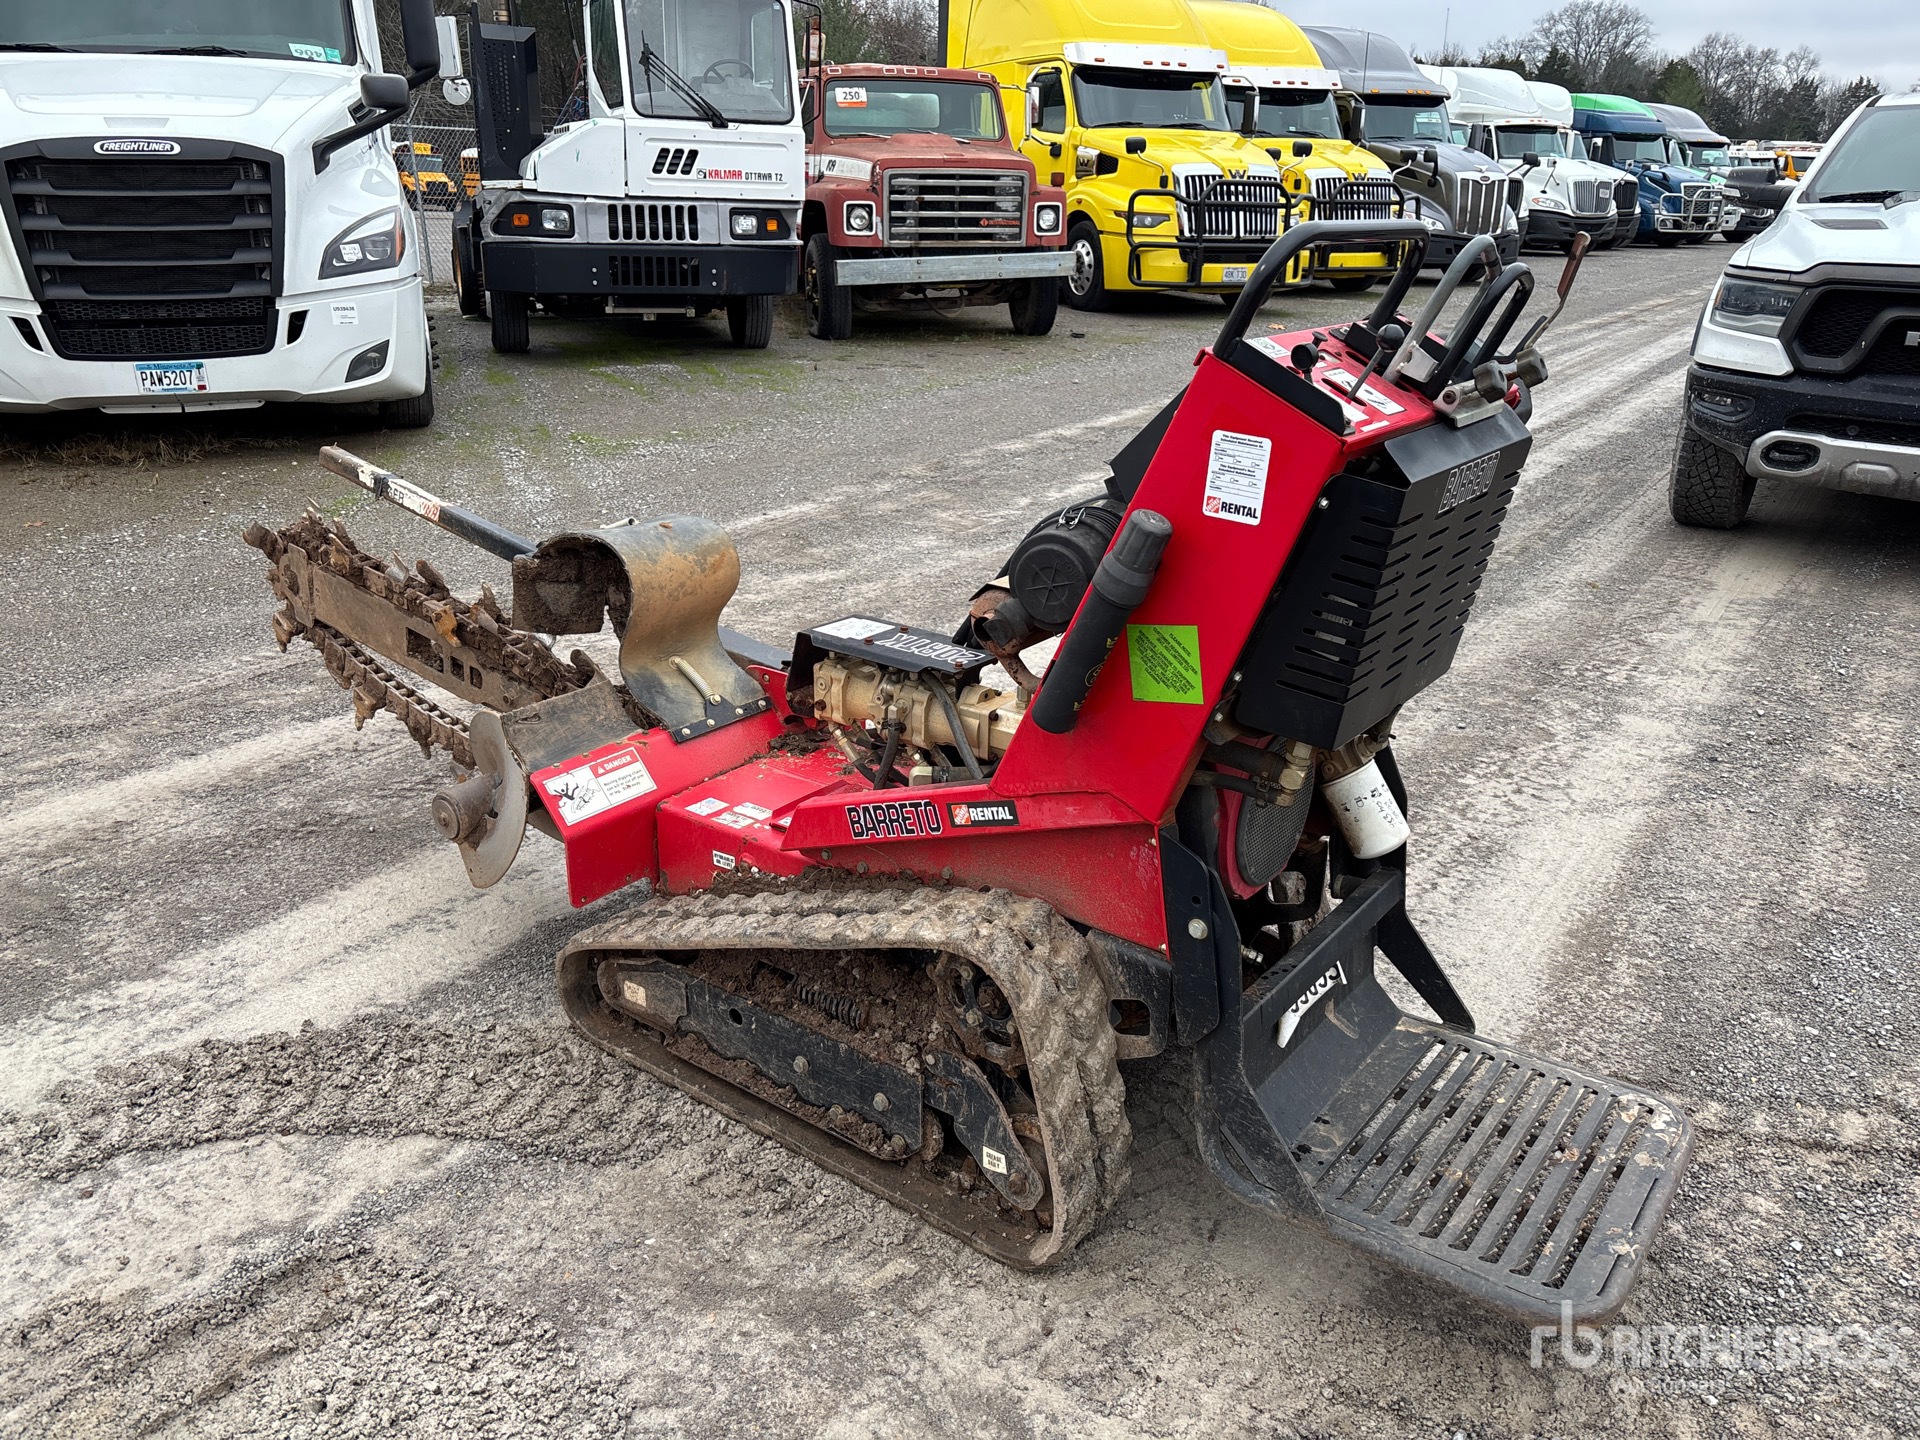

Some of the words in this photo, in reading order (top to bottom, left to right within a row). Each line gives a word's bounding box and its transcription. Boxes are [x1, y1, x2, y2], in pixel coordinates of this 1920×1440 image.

[842, 91, 860, 101] 250
[102, 142, 171, 151] FREIGHTLINER
[708, 169, 743, 180] KALMAR
[744, 171, 773, 181] OTTAWA
[774, 173, 783, 182] T2
[140, 369, 193, 387] PAW5207
[1438, 450, 1500, 514] BARRETO
[1220, 501, 1258, 519] RENTAL
[1169, 633, 1181, 646] PLEASE
[604, 755, 632, 771] DANGER
[844, 799, 943, 839] BARRETO
[969, 806, 1014, 821] RENTAL
